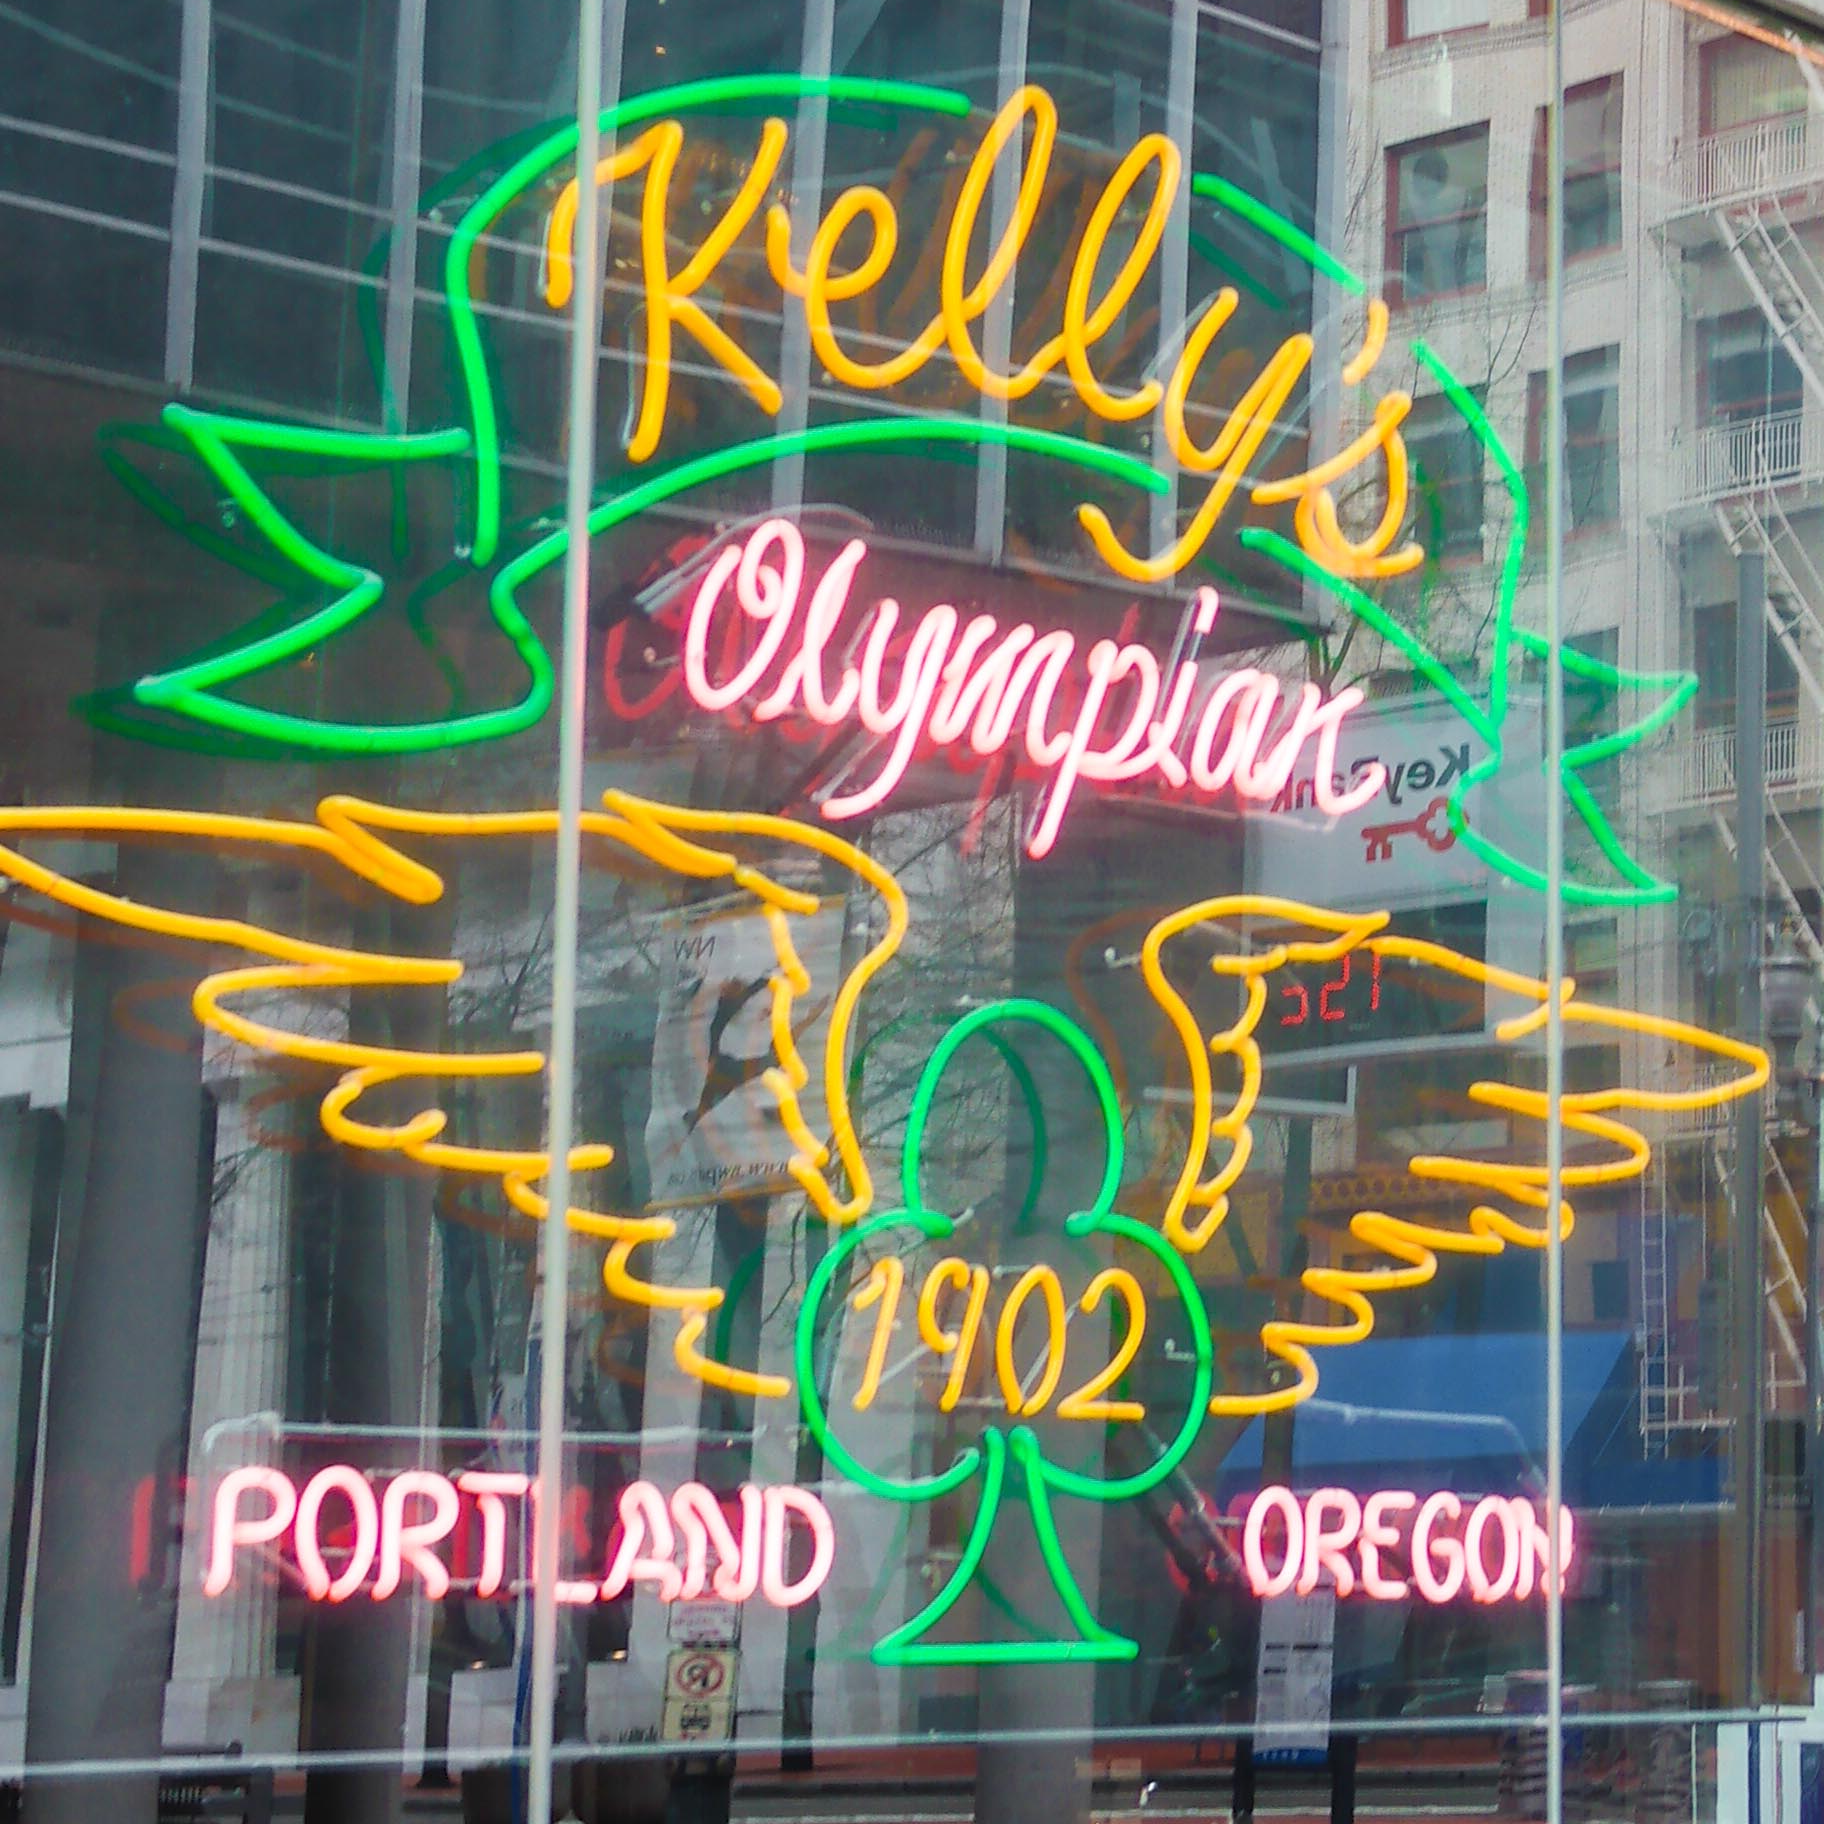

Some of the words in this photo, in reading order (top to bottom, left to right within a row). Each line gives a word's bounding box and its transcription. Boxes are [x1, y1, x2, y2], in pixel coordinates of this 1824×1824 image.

[543, 84, 1424, 582] Kelly's
[684, 518, 1387, 860] Olympian
[854, 1256, 1146, 1417] 1902
[203, 1466, 836, 1606] PORTLAND
[1242, 1484, 1575, 1604] OREGON
